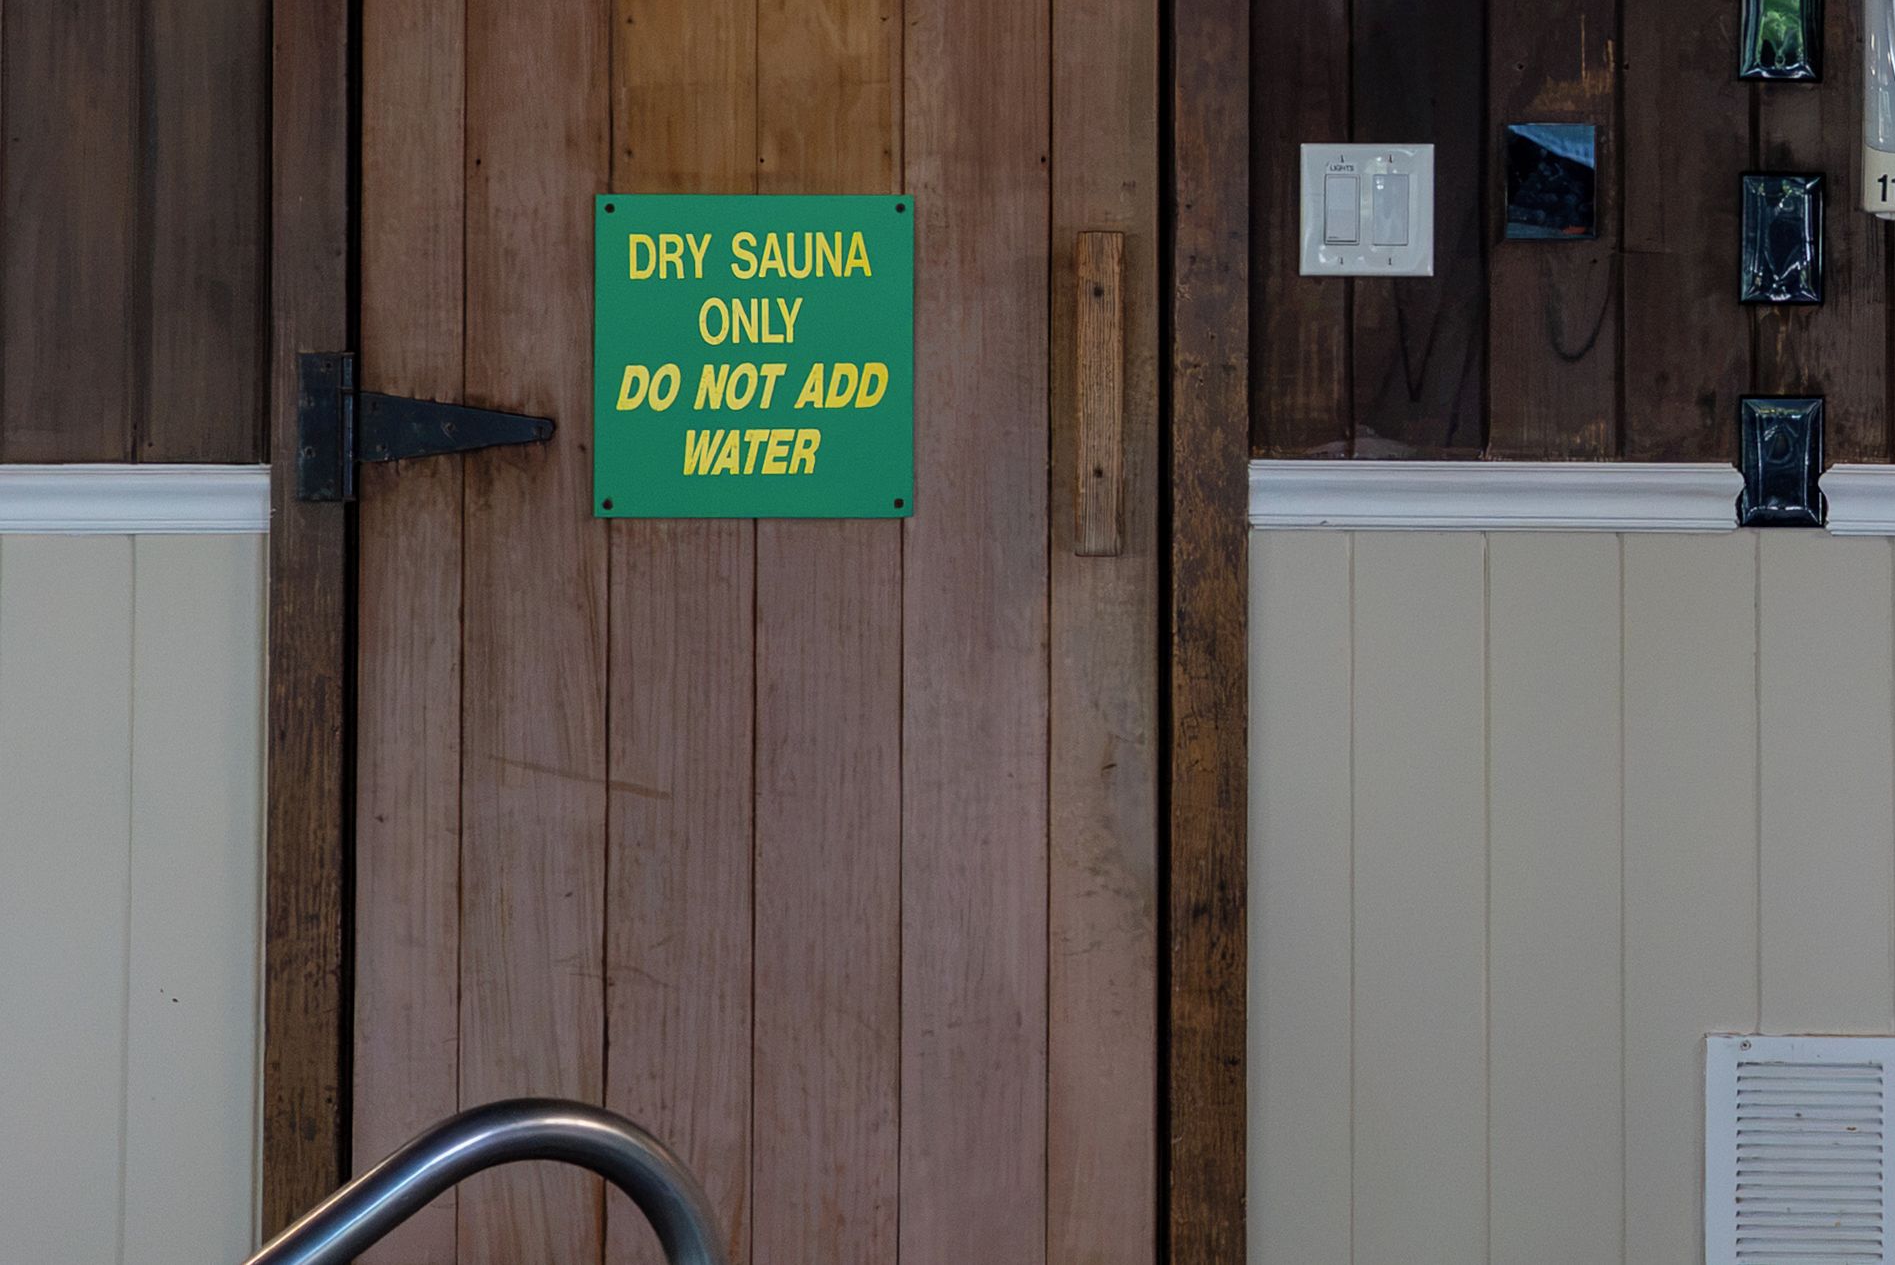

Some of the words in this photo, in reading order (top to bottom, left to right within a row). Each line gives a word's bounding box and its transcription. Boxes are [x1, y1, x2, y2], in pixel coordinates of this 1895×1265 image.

[629, 233, 712, 280] DRY
[731, 231, 872, 279] SAUNA
[699, 297, 803, 345] ONLY
[616, 363, 681, 411] DO
[694, 363, 787, 410] NOT
[794, 362, 889, 409] ADD
[683, 428, 821, 475] WATER
